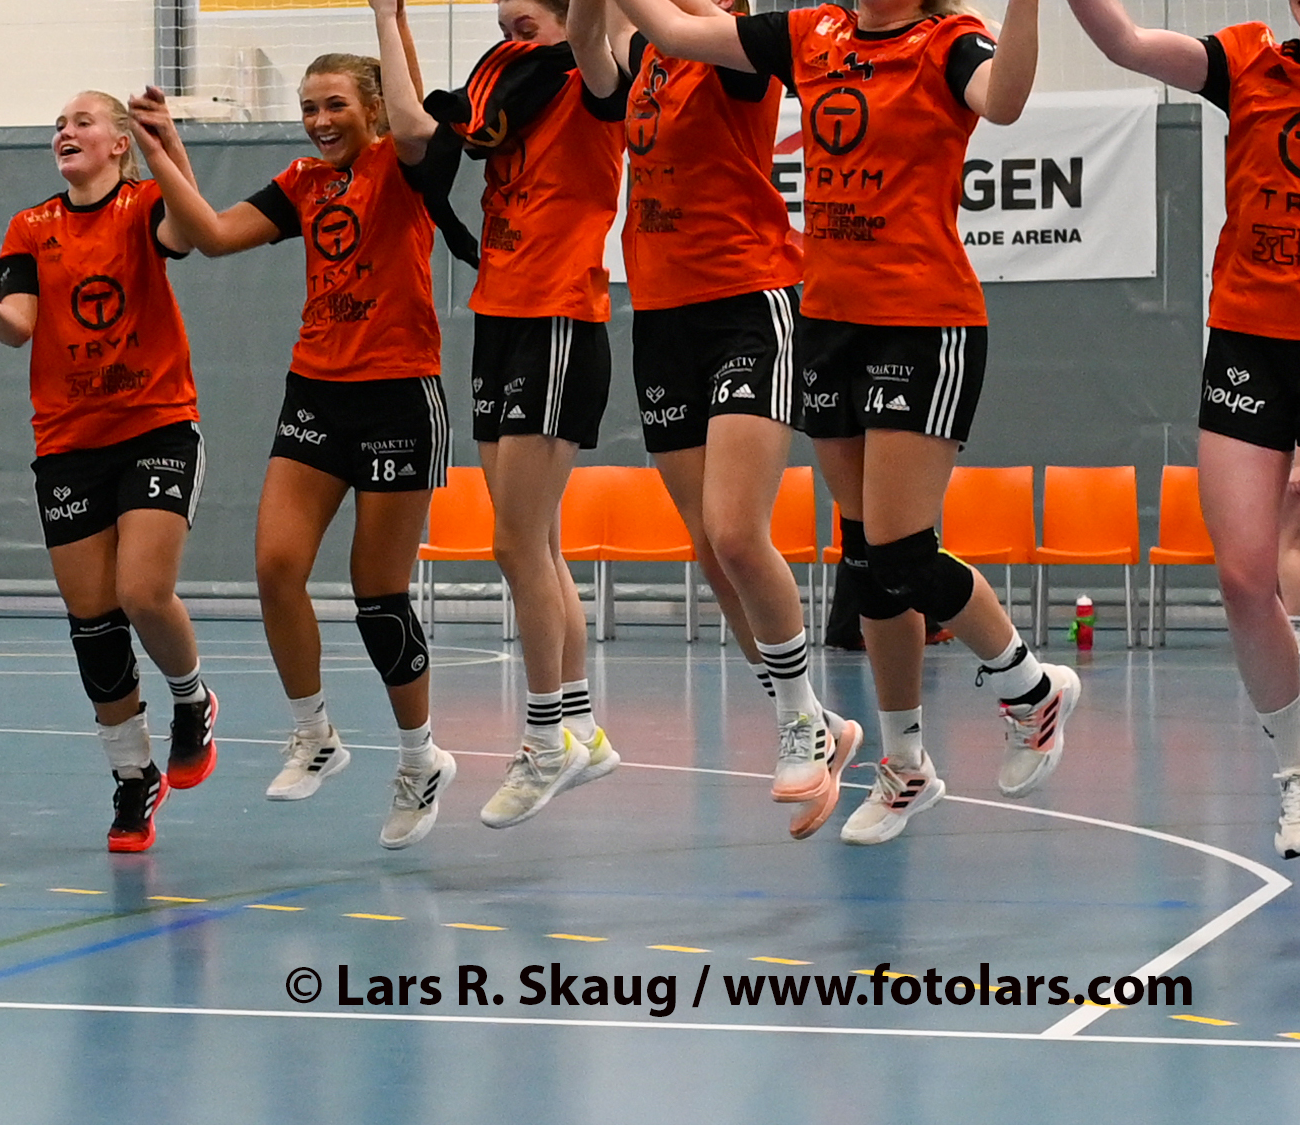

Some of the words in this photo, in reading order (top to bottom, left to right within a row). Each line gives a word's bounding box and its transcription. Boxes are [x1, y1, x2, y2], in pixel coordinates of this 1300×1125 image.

[1011, 228, 1082, 245] ARENA
[361, 439, 417, 454] PROAKTIV
[137, 458, 187, 471] PROAKTIV
[371, 458, 396, 482] 18
[148, 476, 160, 498] 5
